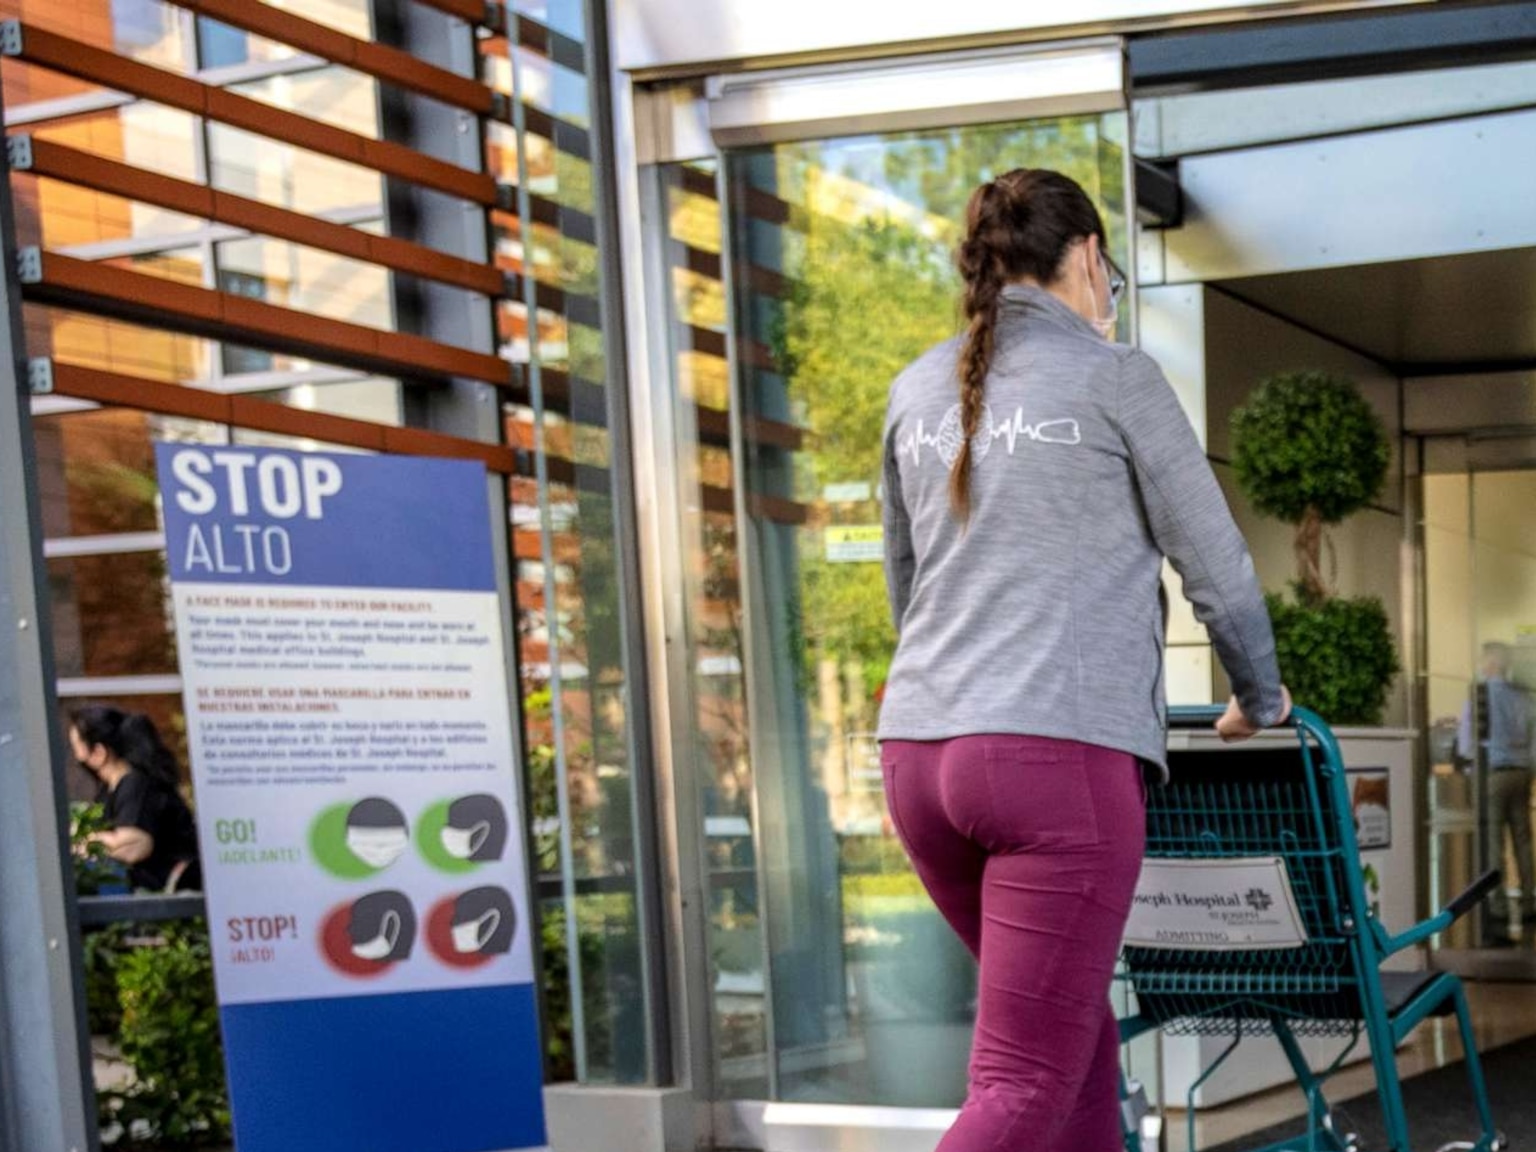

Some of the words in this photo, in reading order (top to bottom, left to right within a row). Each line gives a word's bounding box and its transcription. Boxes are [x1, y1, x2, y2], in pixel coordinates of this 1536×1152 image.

[171, 450, 343, 519] STOP
[184, 523, 293, 575] ALTO
[216, 818, 257, 844] GO!
[1134, 891, 1172, 908] seph
[1175, 892, 1241, 910] Hospital
[227, 915, 298, 942] STOP!
